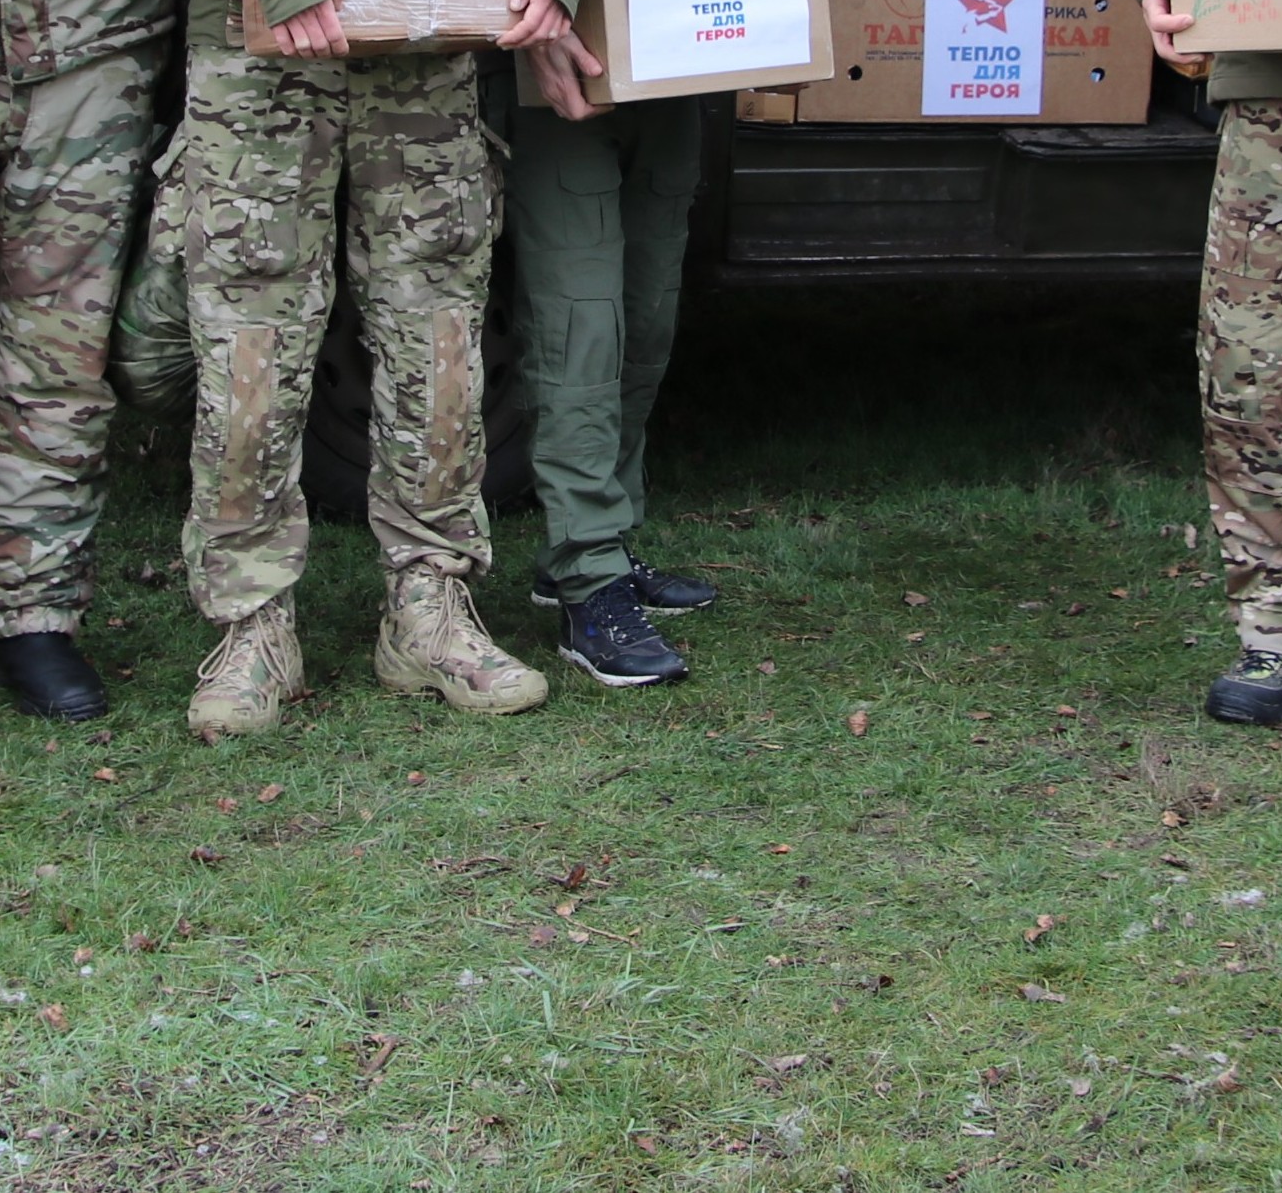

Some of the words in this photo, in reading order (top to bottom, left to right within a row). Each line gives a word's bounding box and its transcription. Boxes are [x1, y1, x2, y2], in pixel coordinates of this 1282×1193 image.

[692, 0, 743, 15] ТЕПЛО
[1044, 7, 1087, 19] РИКА
[712, 14, 745, 27] ДЛЯ
[696, 27, 745, 42] ГЕРОЯ
[864, 24, 924, 45] ТАГ
[1047, 25, 1110, 47] КАЯ
[947, 46, 1021, 61] ТЕПЛО
[973, 65, 1020, 80] ДЛЯ
[950, 83, 1020, 99] ГЕРОЯ
